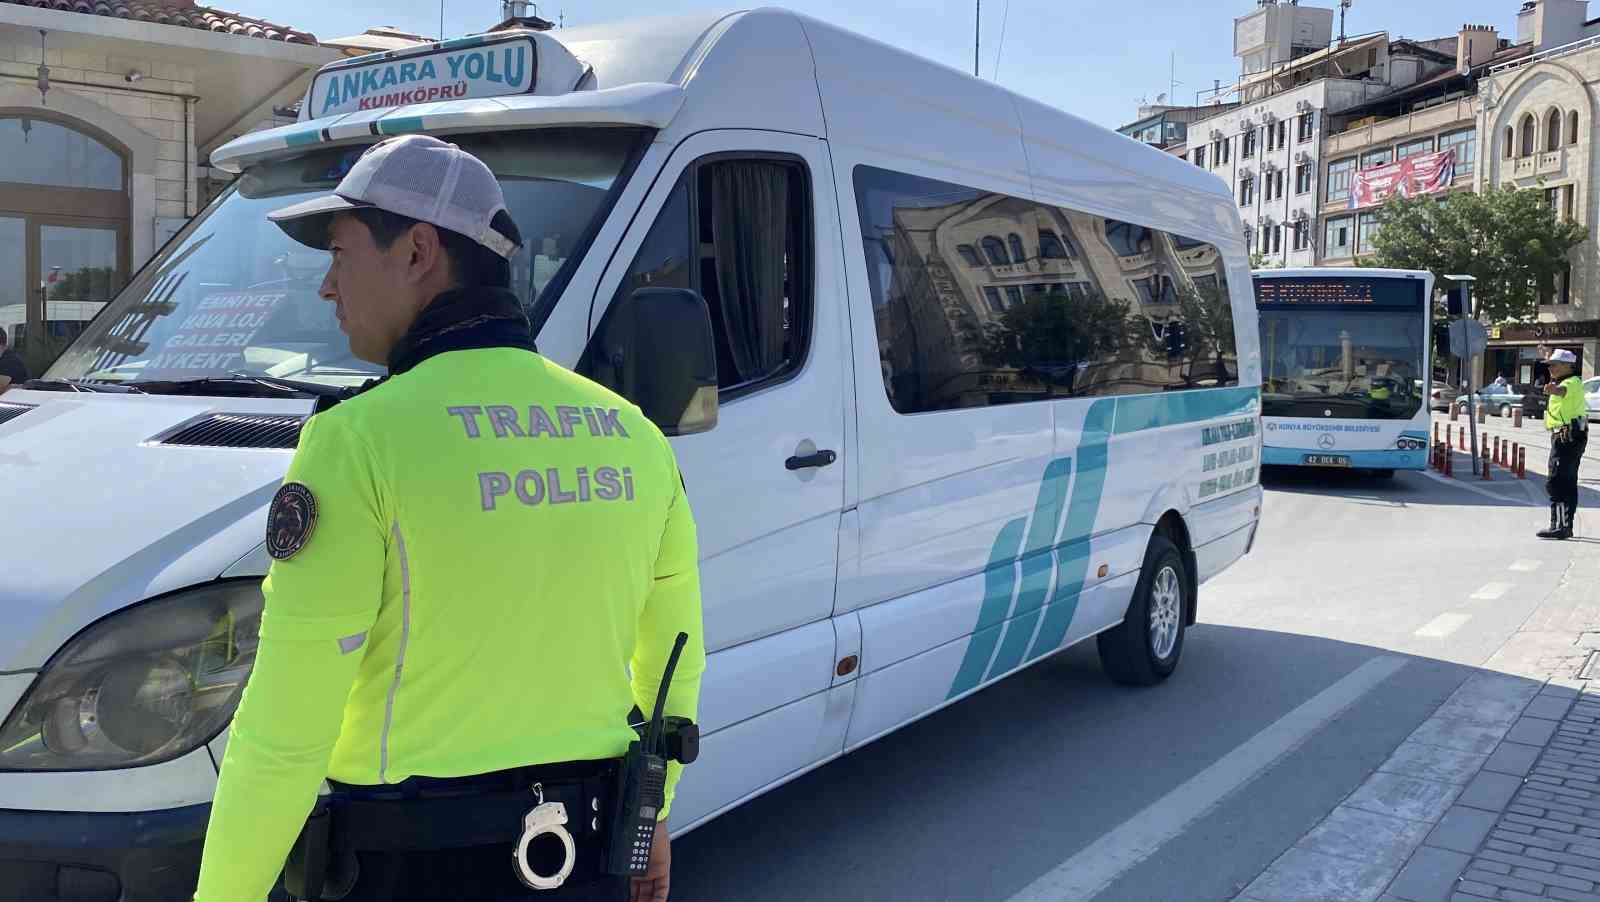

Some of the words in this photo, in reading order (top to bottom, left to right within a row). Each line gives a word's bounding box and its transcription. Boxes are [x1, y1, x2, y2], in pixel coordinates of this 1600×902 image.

[323, 60, 436, 114] ANKARA
[446, 46, 524, 87] YOLU
[359, 80, 468, 111] KUMKÖPRÜ
[179, 312, 224, 329] HAVA
[150, 351, 240, 369] AYKENT
